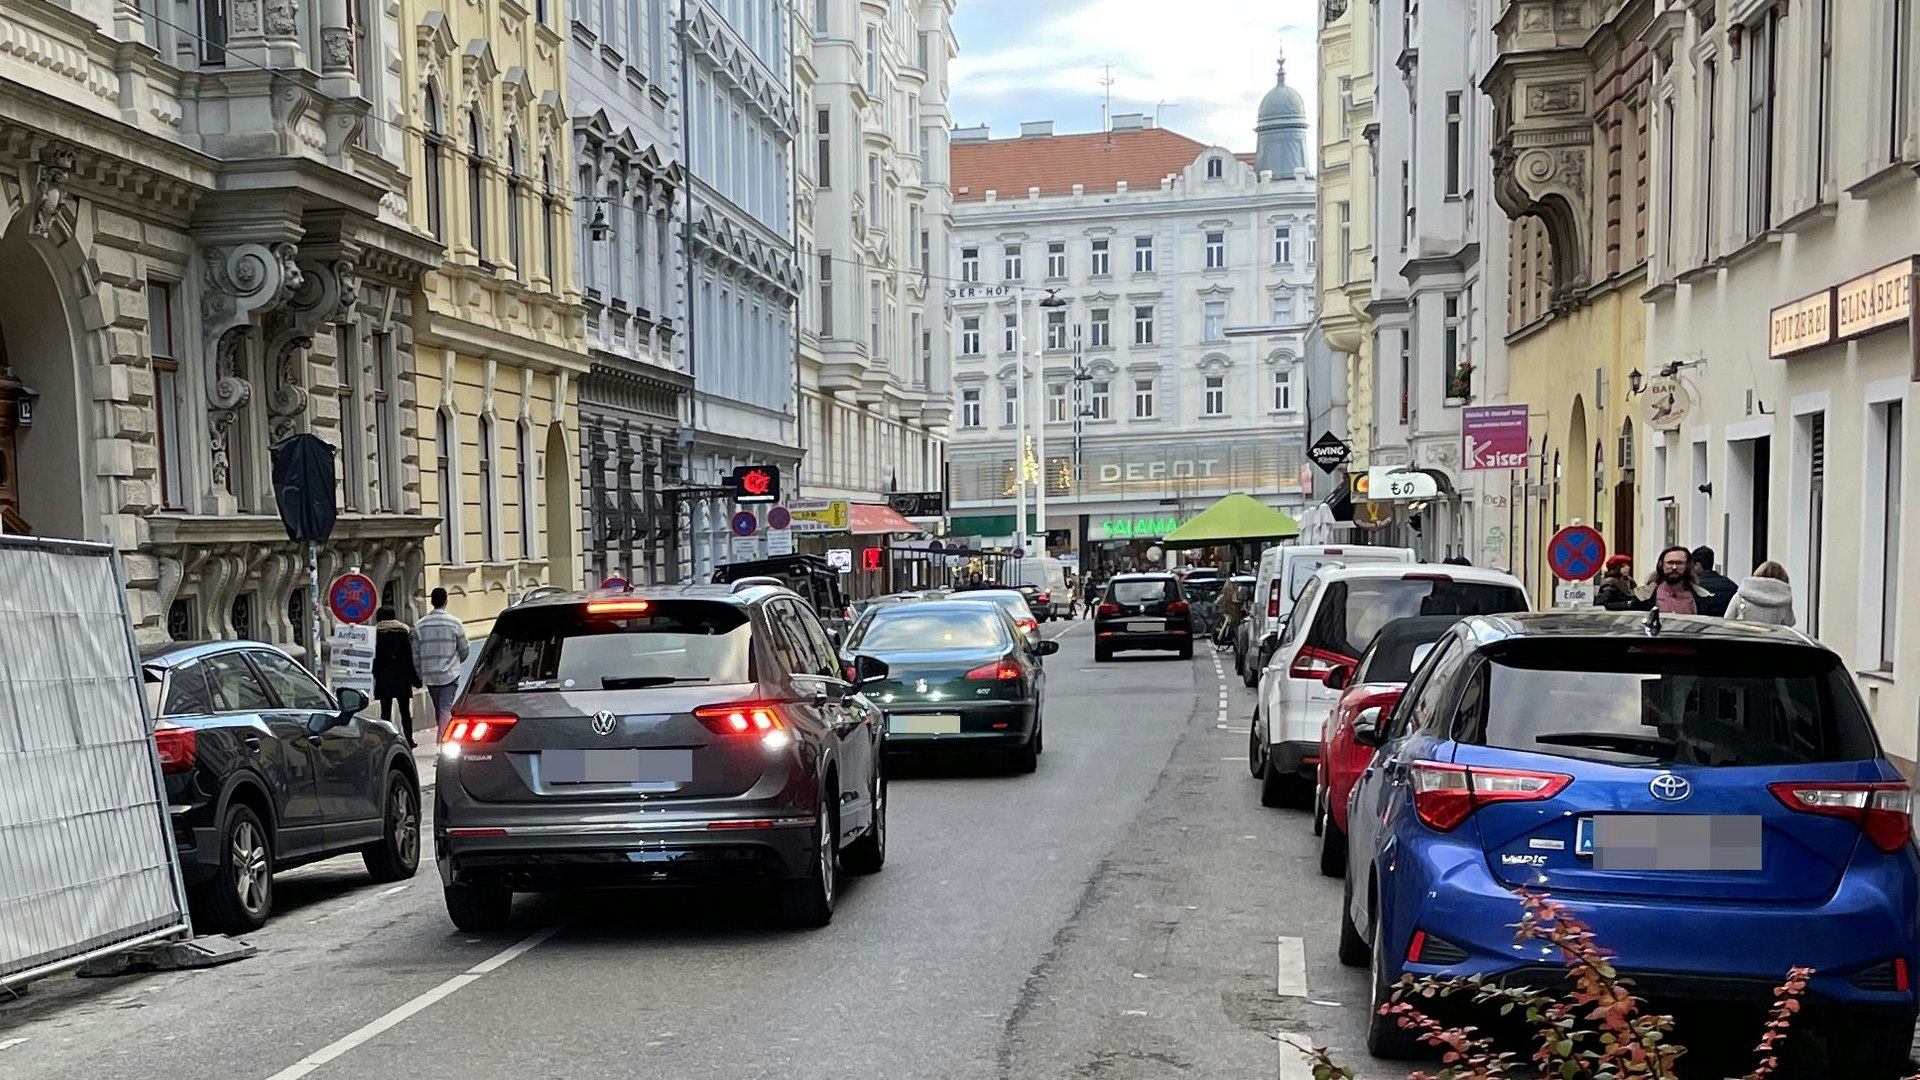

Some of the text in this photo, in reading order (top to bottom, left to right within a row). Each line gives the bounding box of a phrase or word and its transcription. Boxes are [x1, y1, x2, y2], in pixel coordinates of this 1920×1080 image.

[1774, 274, 1910, 346] PUTZEREI ELISABETH
[1652, 384, 1676, 394] BAR
[1312, 446, 1344, 457] SWING
[1100, 459, 1218, 481] DEPOT
[1390, 482, 1415, 496] もの
[1103, 516, 1186, 538] SALAMA
[1564, 590, 1586, 599] Ende
[338, 631, 366, 642] Anfang
